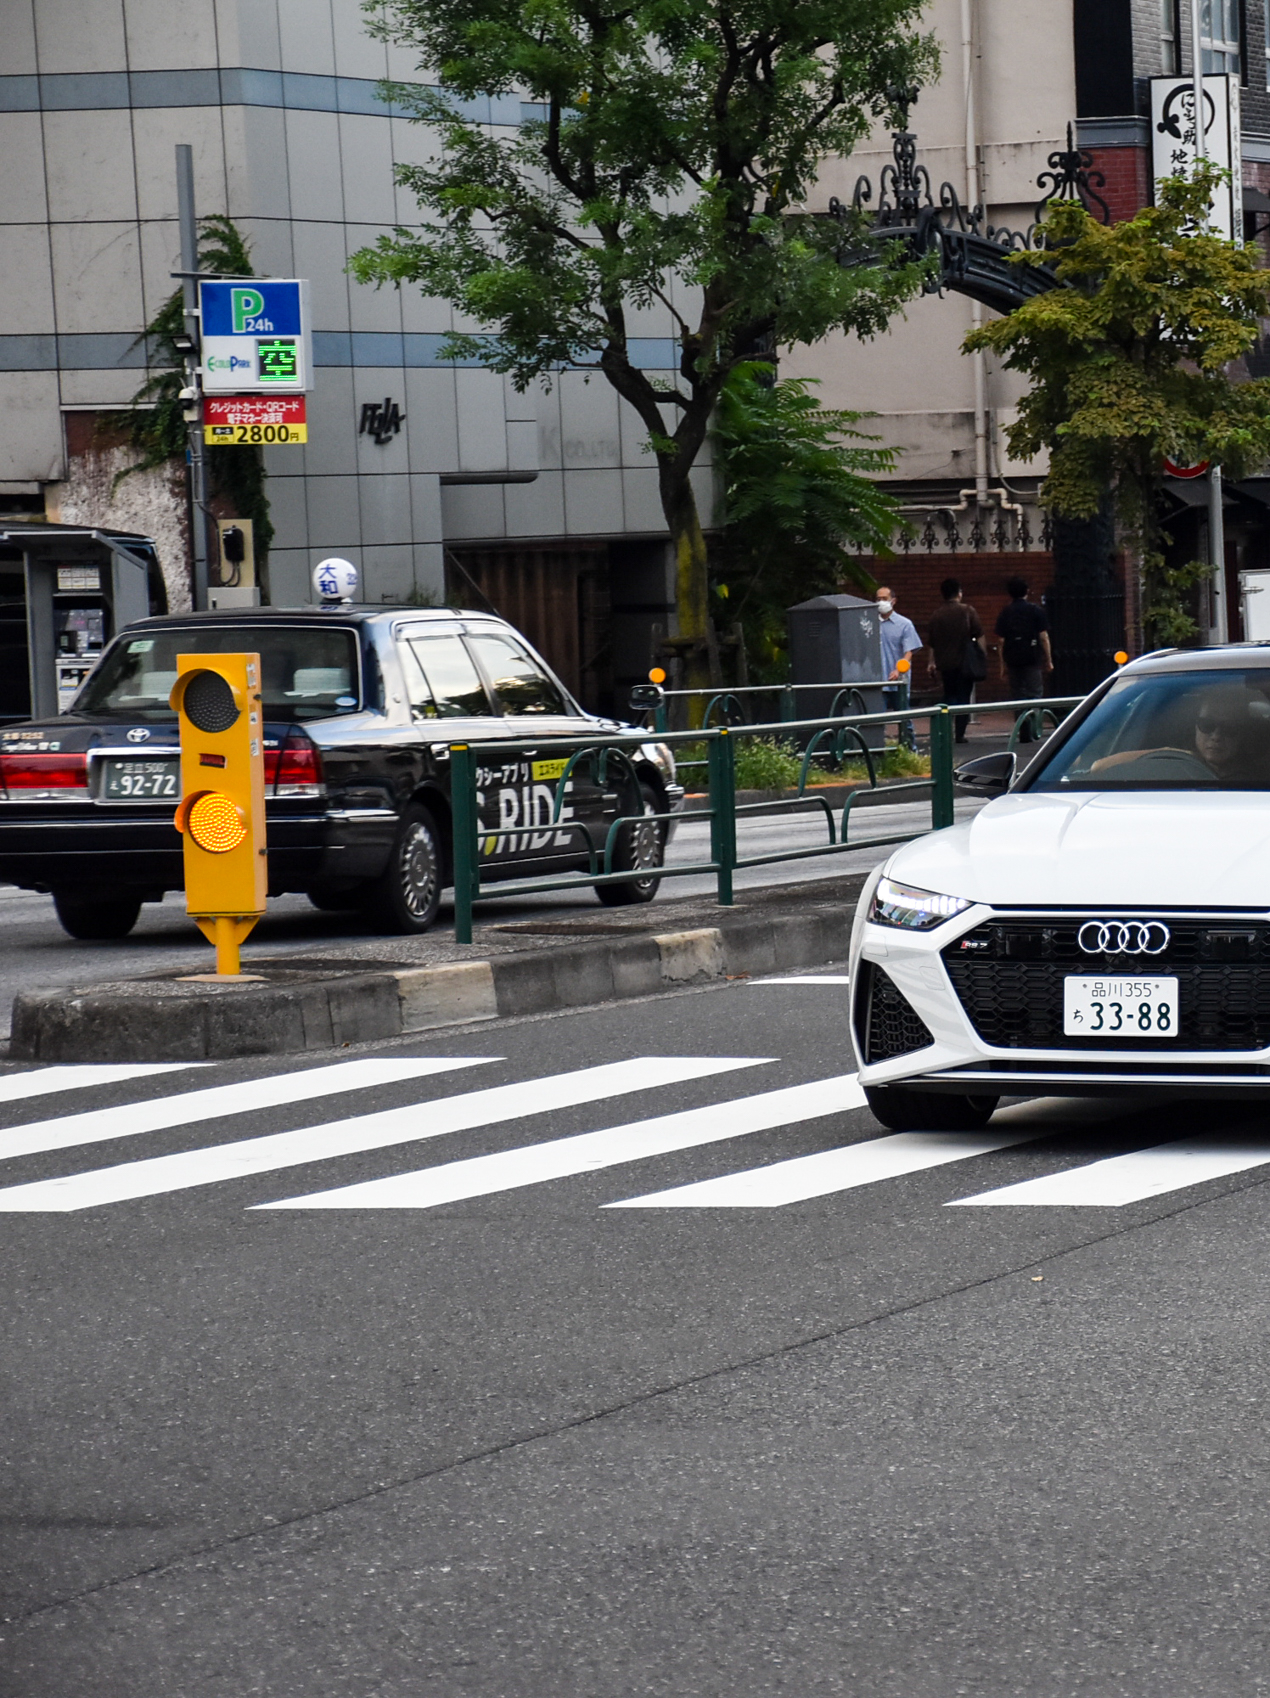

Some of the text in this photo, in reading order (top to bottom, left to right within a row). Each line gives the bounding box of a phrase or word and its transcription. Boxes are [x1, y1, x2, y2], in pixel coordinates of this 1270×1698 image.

[230, 288, 275, 333] P 24h
[257, 340, 298, 382] 空
[318, 564, 339, 595] 大和
[120, 774, 177, 796] 92-72
[1072, 1001, 1171, 1032] ち 33-88
